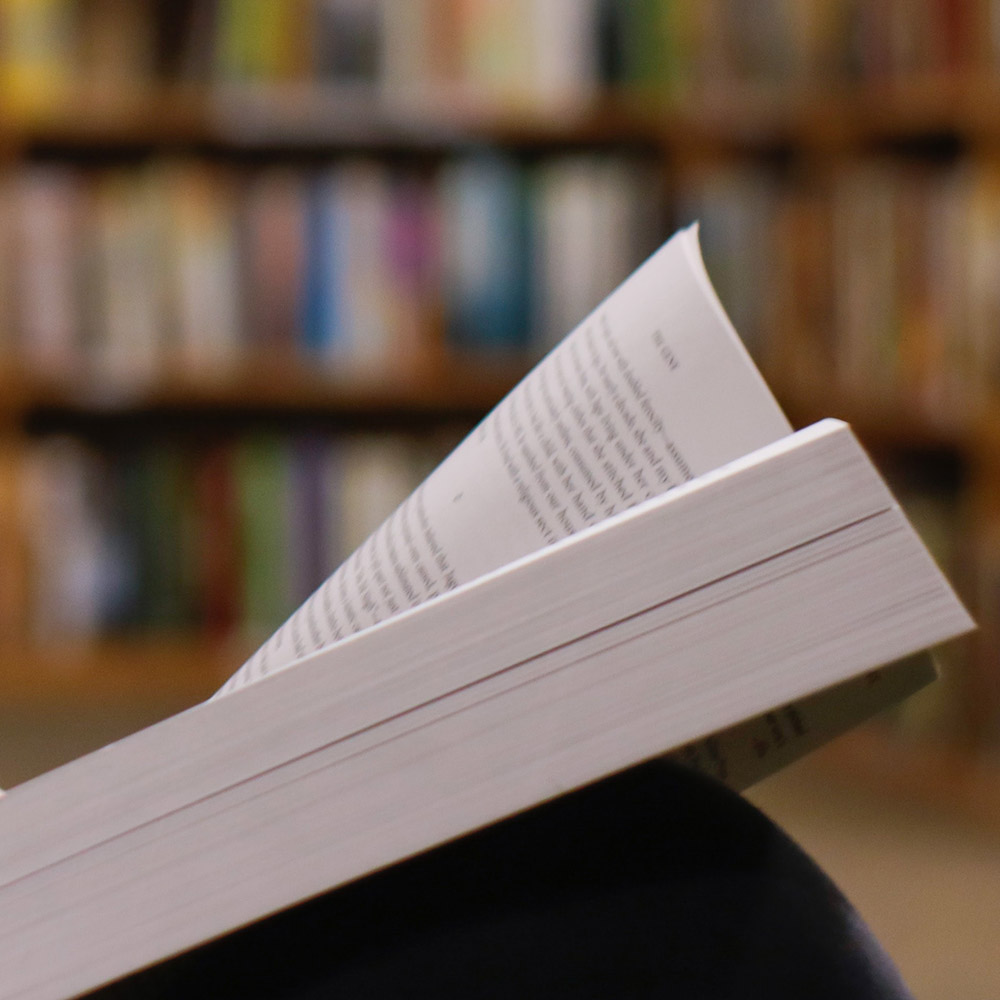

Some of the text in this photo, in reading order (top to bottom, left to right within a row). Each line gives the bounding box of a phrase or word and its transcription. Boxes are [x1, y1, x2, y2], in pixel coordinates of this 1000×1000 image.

[591, 441, 608, 462] she
[601, 458, 632, 503] stitched
[612, 437, 637, 470] under
[631, 467, 650, 491] her
[641, 441, 663, 468] and
[652, 464, 670, 486] my
[513, 478, 542, 521] religious
[535, 513, 553, 539] sect
[545, 489, 562, 513] our
[560, 473, 579, 496] her
[571, 490, 595, 523] hand
[592, 488, 609, 508] by
